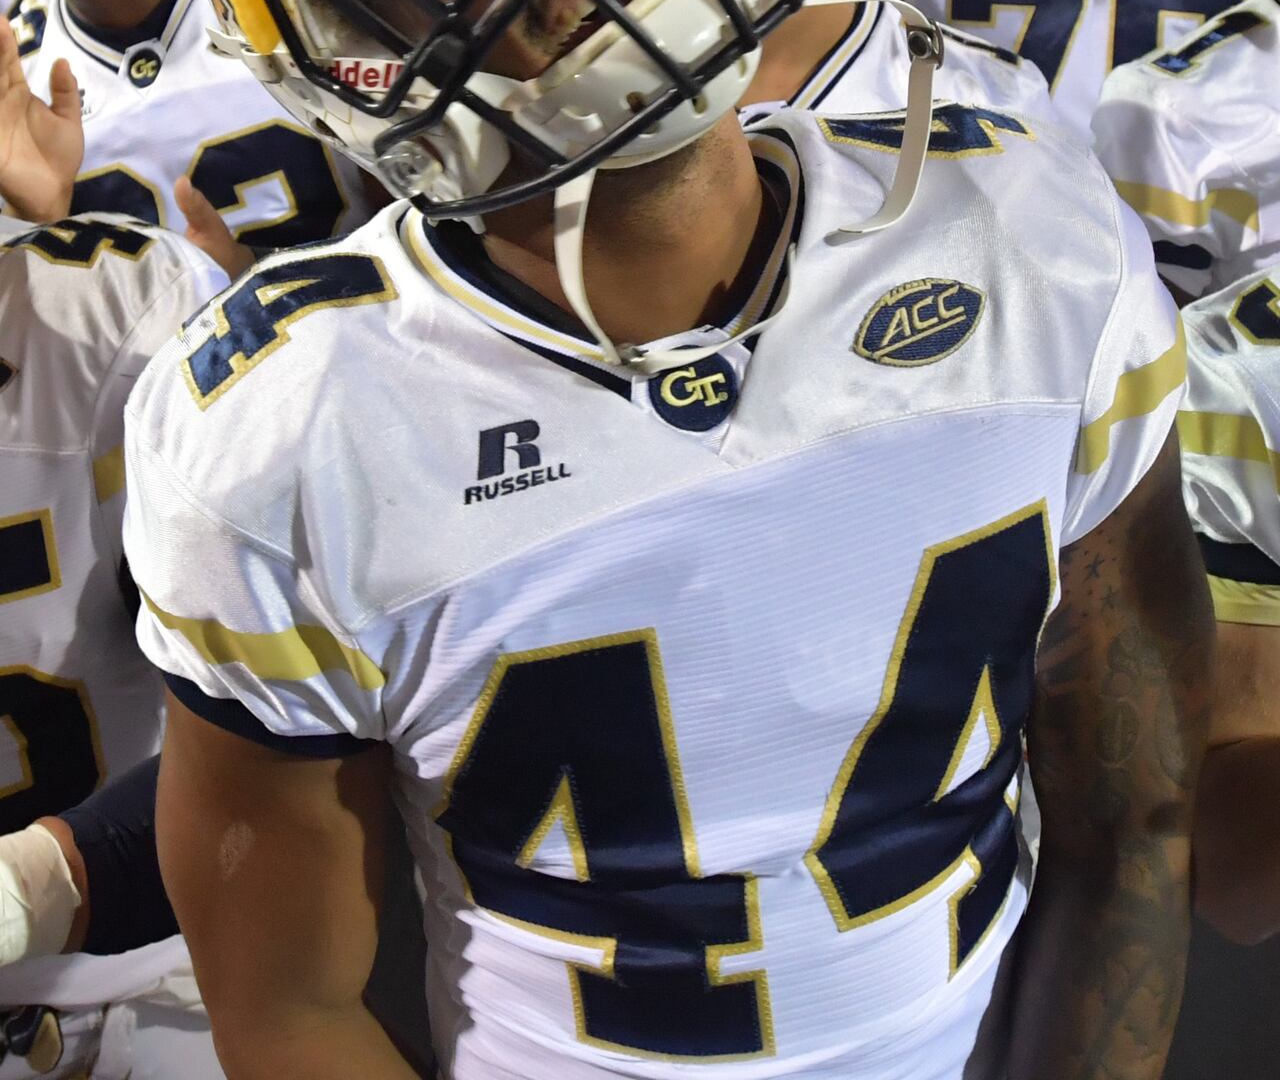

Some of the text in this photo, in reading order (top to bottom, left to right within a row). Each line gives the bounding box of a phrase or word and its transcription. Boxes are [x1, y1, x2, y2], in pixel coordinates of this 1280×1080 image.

[879, 284, 967, 350] ACC
[659, 365, 728, 409] GT
[463, 461, 573, 506] RUSSELL
[433, 495, 1060, 1065] 44
